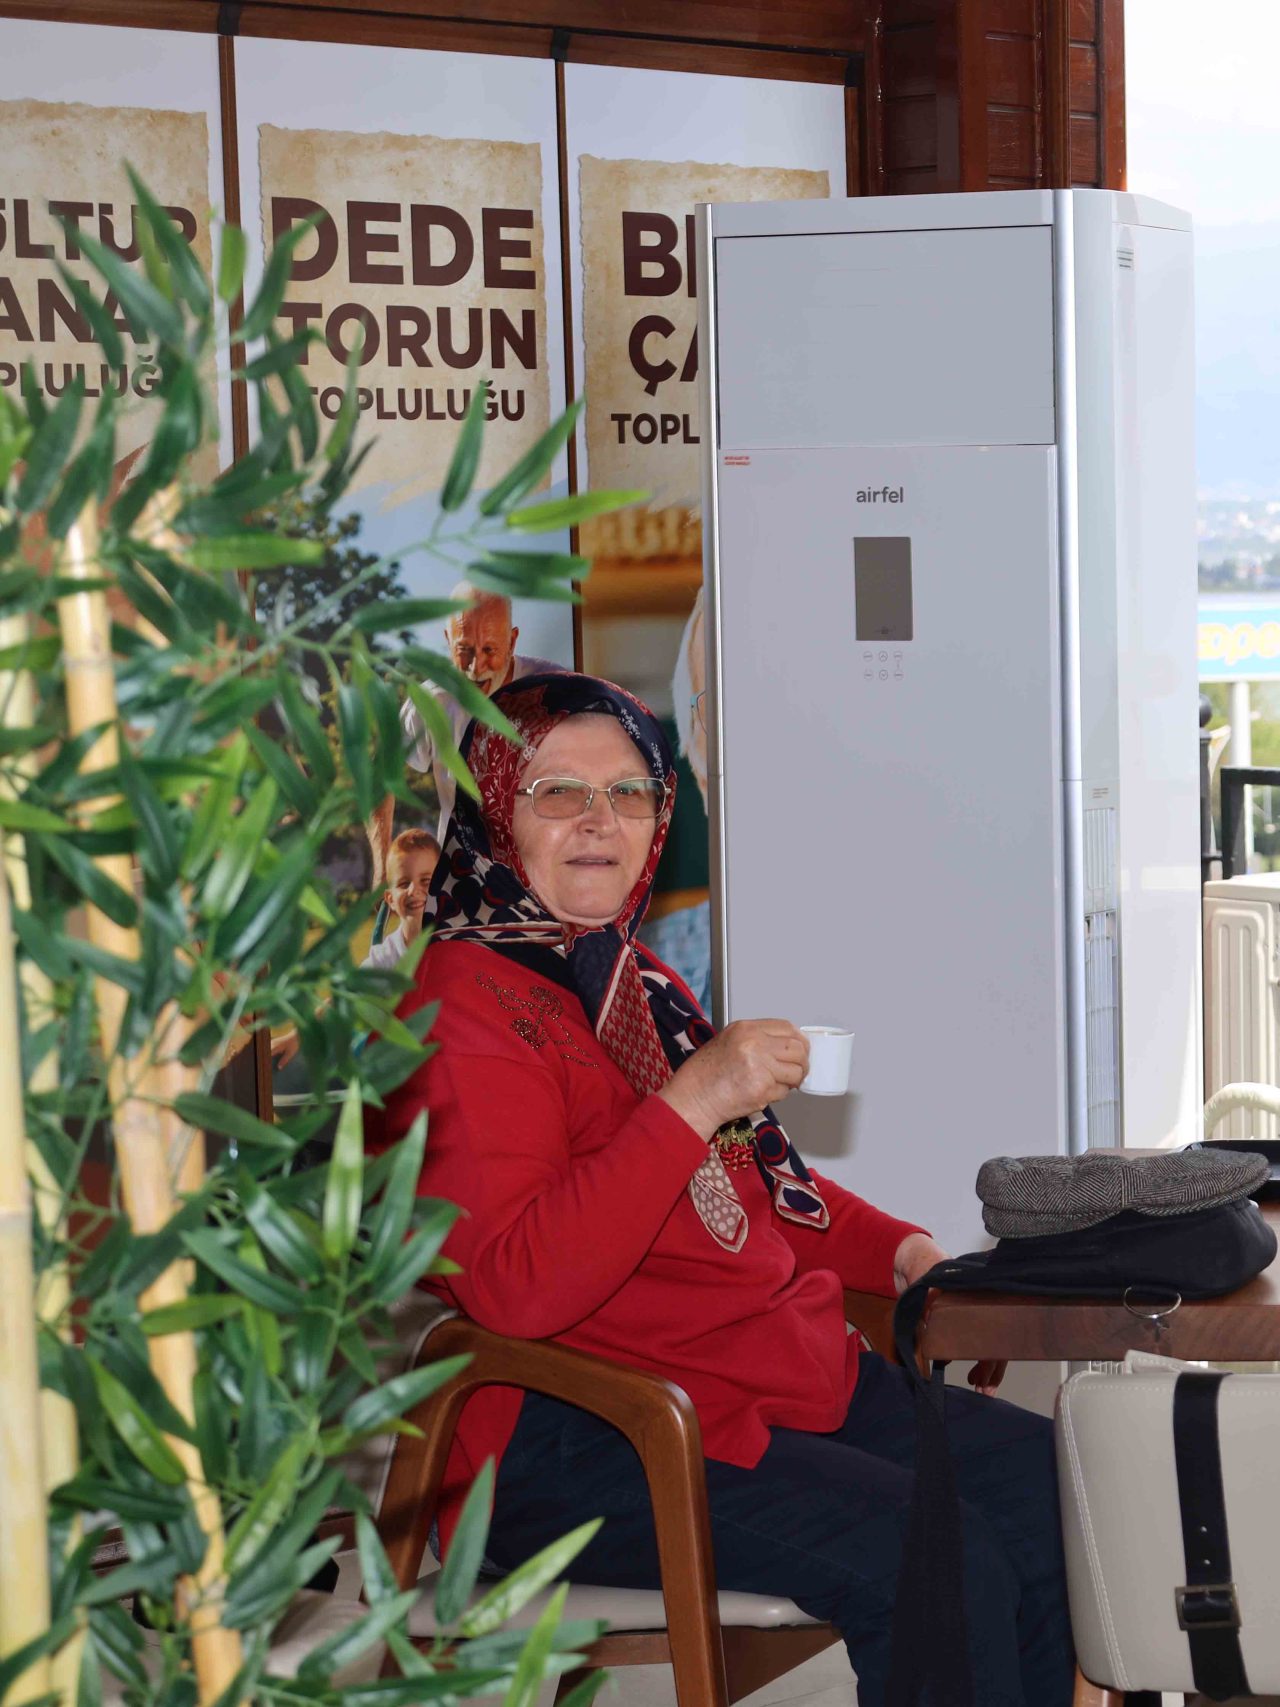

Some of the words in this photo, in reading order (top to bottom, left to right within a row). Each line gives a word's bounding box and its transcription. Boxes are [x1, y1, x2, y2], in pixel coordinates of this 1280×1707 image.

[0, 198, 197, 262] LTÜ
[271, 196, 536, 289] DEDE
[622, 211, 697, 298] B
[277, 302, 537, 369] TORUN
[309, 380, 525, 421] OPLULUĞU
[610, 413, 700, 444] TOPL
[856, 486, 904, 504] airfel
